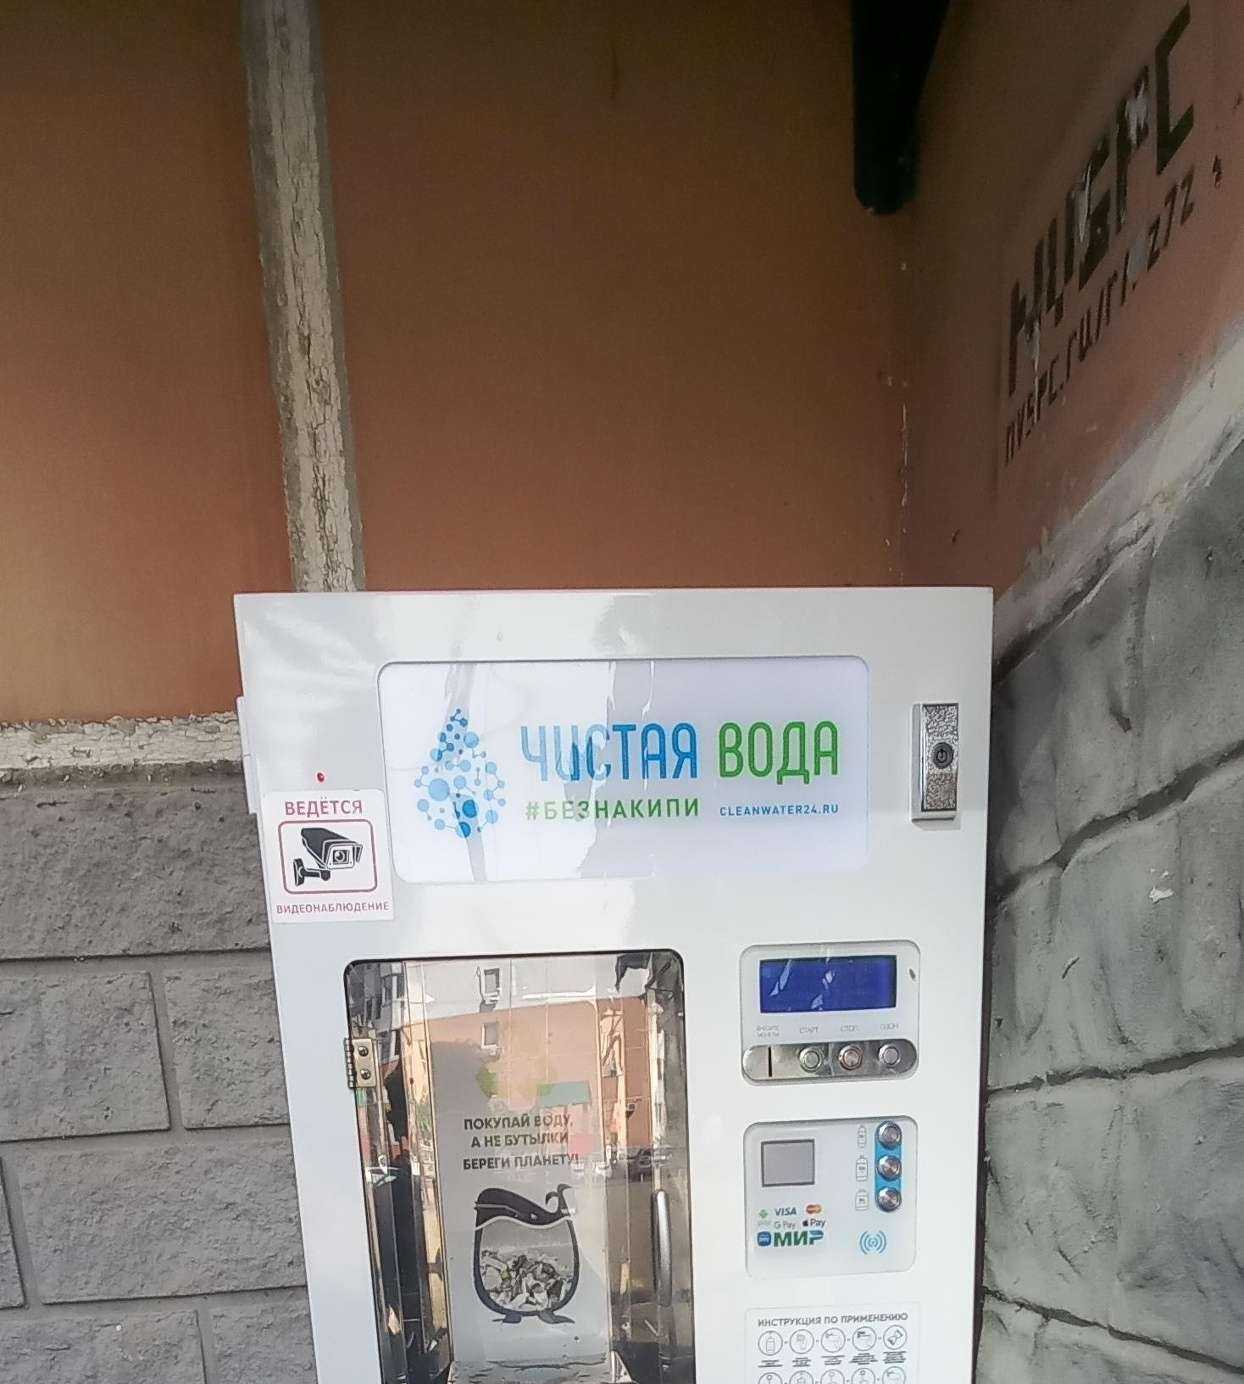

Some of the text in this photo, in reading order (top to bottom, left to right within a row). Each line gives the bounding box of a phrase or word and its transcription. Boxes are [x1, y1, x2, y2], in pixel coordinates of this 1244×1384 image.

[520, 721, 838, 785] ЧИСТАЯ ВОДА
[284, 796, 363, 818] ВЕДЁТСЯ
[525, 798, 699, 821] #БЕЗНАКИПИ
[719, 804, 839, 816] CLEANWATER24.RU
[276, 901, 390, 914] ВИДЕОНАБЛЮДЕНИЕ
[463, 1113, 531, 1130] ПОКУПАЙ
[471, 1131, 568, 1148] А НЕ БУТЫЛКИ
[463, 1153, 579, 1170] БЕРЕГИ ПЛАНЕТУ!
[774, 1207, 797, 1217] VISA
[773, 1230, 824, 1248] МИР
[757, 1312, 909, 1327] ИНСТРУКЦИЯ ПО ПРИМЕНЕНИЮ
